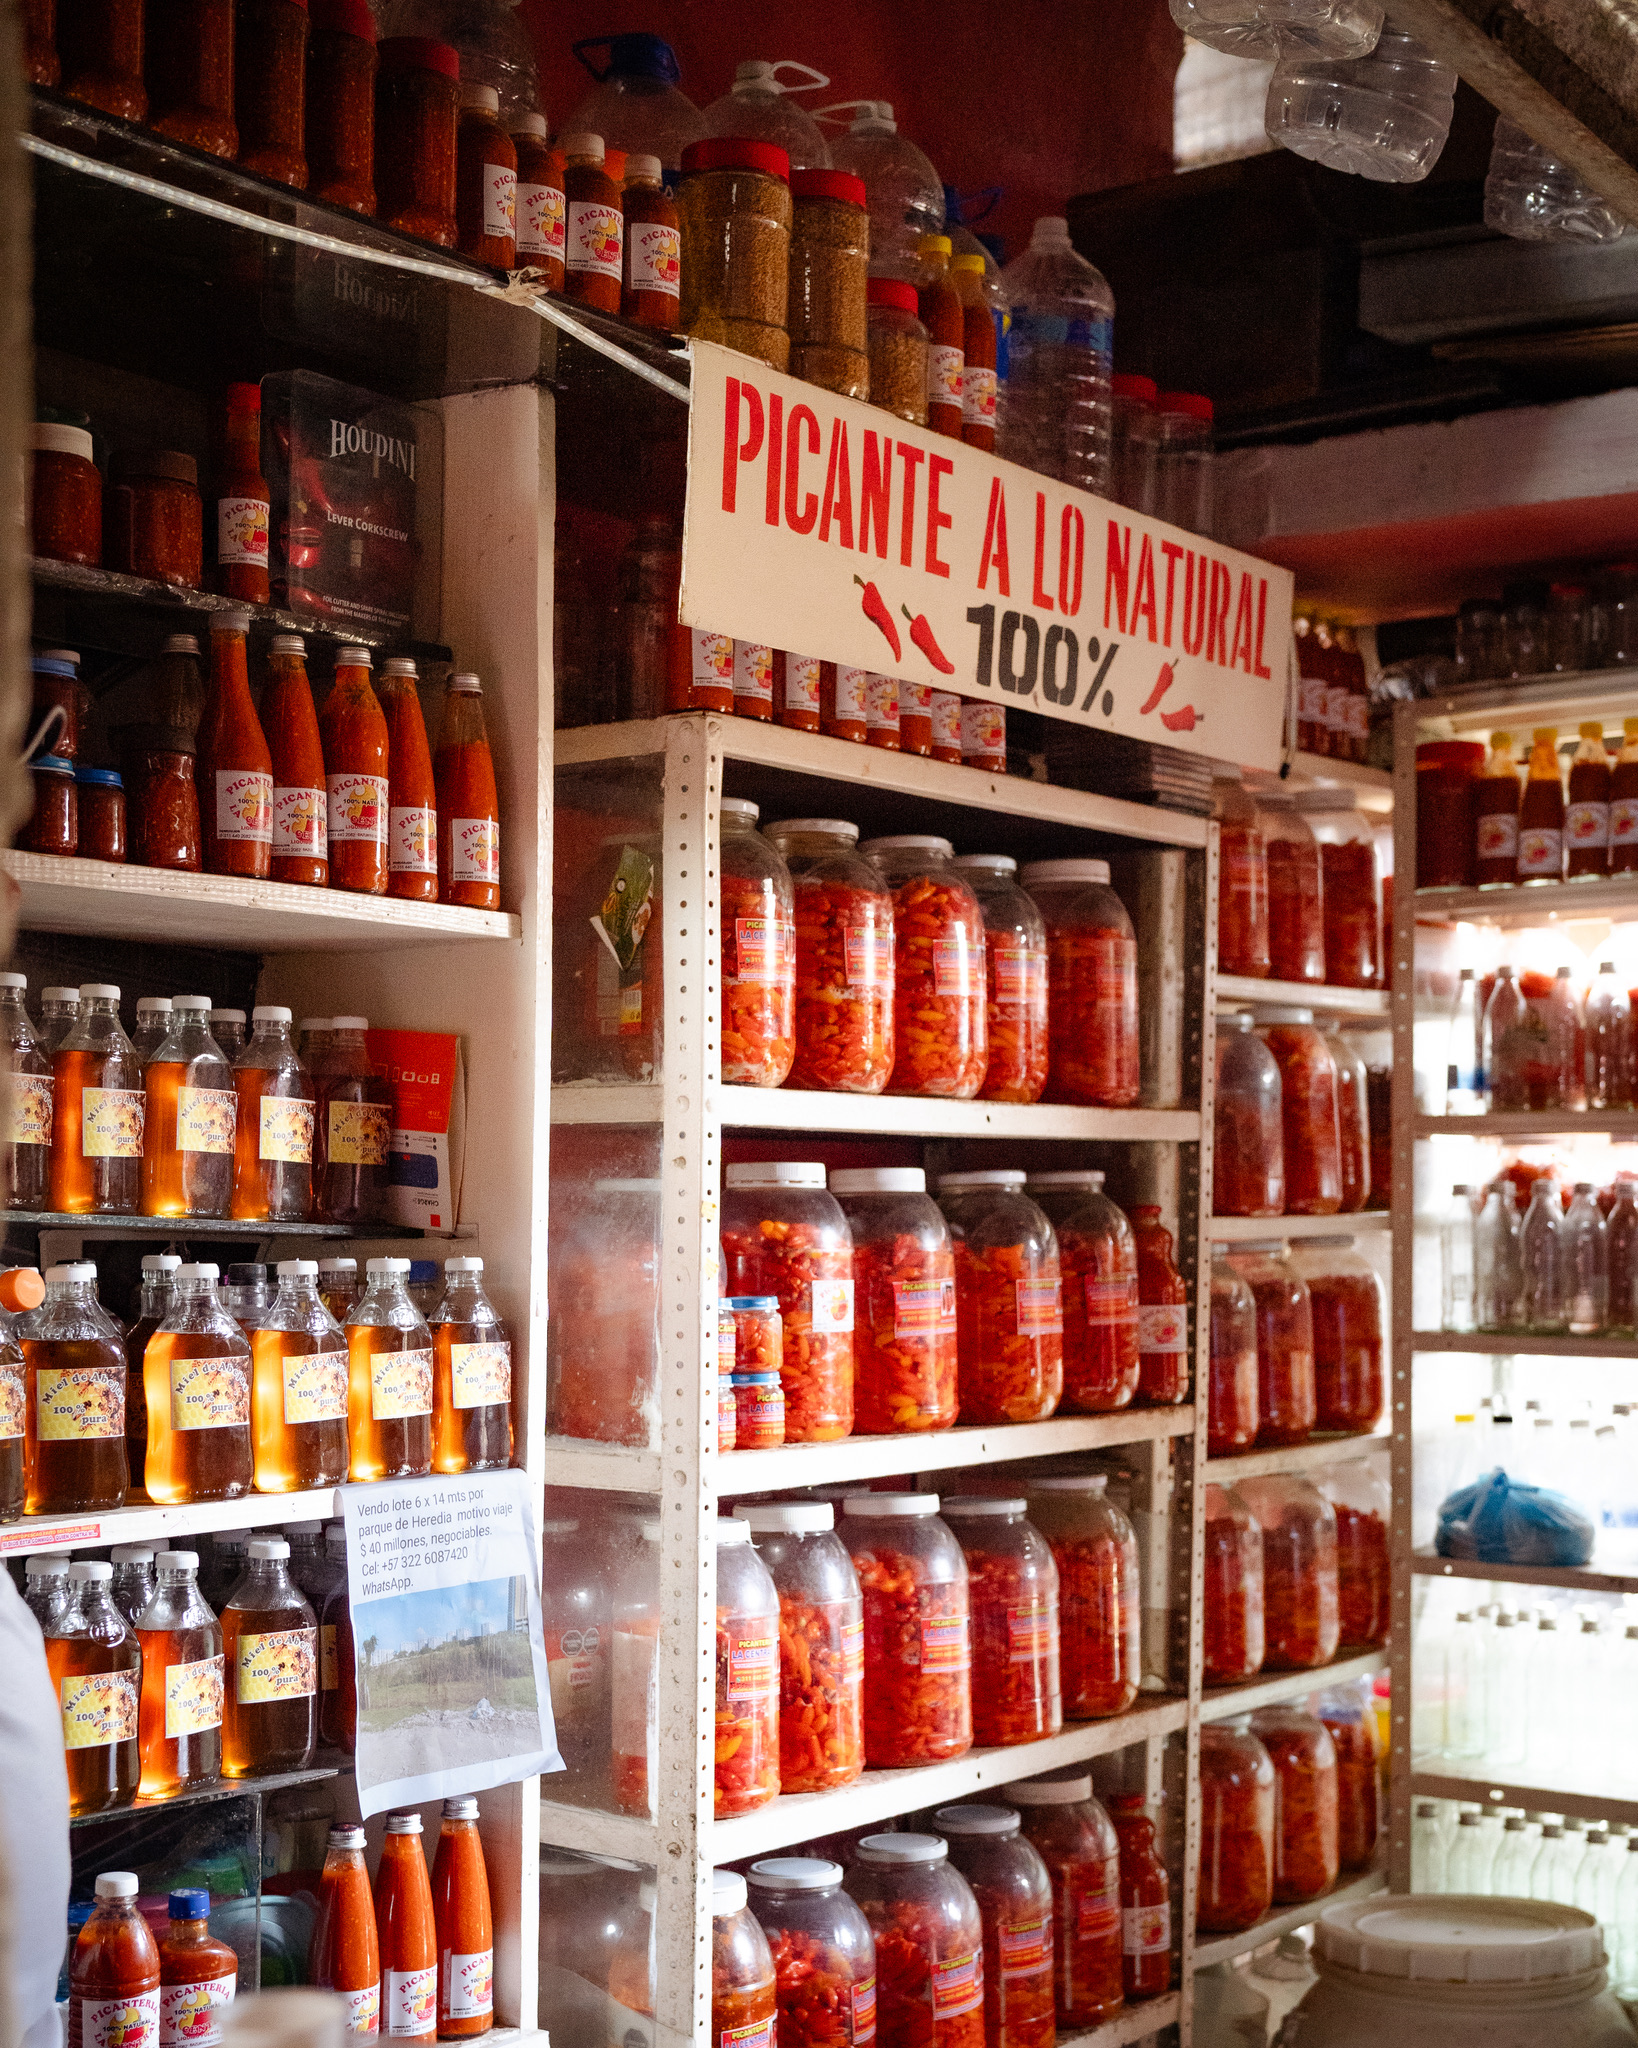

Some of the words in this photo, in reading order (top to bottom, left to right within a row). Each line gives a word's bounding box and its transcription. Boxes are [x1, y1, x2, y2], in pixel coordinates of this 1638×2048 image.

[329, 418, 417, 482] HOUDINI
[327, 509, 353, 528] LEVER
[355, 517, 408, 543] CORKSCREW
[722, 376, 954, 579] PICANTE
[977, 476, 1011, 598] A
[1032, 491, 1085, 617] LO
[1104, 519, 1271, 681] NATURAL
[966, 603, 1120, 717] 100%
[229, 805, 242, 819] LA
[335, 804, 346, 819] LA
[279, 819, 290, 834] LA
[402, 838, 412, 851] LA
[464, 848, 474, 862] LA
[87, 1099, 108, 1123] Miel
[110, 1096, 122, 1104] de
[181, 1096, 201, 1119] Miel
[203, 1094, 214, 1103] de
[264, 1107, 283, 1129] Miel
[286, 1105, 295, 1113] de
[333, 1112, 354, 1134] Miel
[22, 1122, 41, 1131] pura
[117, 1136, 134, 1144] pura
[456, 1352, 475, 1375] Miel
[477, 1347, 488, 1356] de
[175, 1367, 199, 1394] Miel
[202, 1363, 216, 1372] de
[218, 1362, 248, 1391] Abejas
[287, 1362, 310, 1389] Miel
[311, 1359, 323, 1368] de
[373, 1360, 394, 1385] Miel
[396, 1356, 408, 1365] de
[42, 1377, 68, 1404] Miel
[71, 1374, 87, 1384] de
[90, 1373, 125, 1404] Abejas
[485, 1384, 501, 1393] pura
[319, 1397, 338, 1406] pura
[404, 1393, 421, 1402] pura
[211, 1404, 233, 1413] pura
[750, 1404, 762, 1412] LA
[81, 1415, 107, 1425] pura
[357, 1501, 390, 1516] Vendo
[392, 1499, 412, 1512] lote
[415, 1496, 422, 1508] 6
[424, 1497, 430, 1507] x
[433, 1492, 445, 1505] 14
[447, 1491, 466, 1503] mts
[468, 1488, 484, 1503] por
[358, 1522, 392, 1540] parque
[395, 1517, 409, 1531] de
[412, 1512, 452, 1528] Heredia
[457, 1506, 491, 1521] motivo
[492, 1503, 513, 1517] viaje
[360, 1543, 367, 1557] $
[369, 1541, 381, 1554] 40
[384, 1536, 428, 1553] millones,
[431, 1525, 493, 1545] negociables.
[361, 1563, 380, 1577] Cel:
[381, 1557, 398, 1571] +57
[401, 1554, 422, 1569] 322
[424, 1546, 469, 1564] 6087420
[361, 1577, 414, 1596] WhatsApp.
[241, 1643, 265, 1668] Miel
[268, 1638, 282, 1647] de
[732, 1650, 744, 1659] LA
[169, 1673, 190, 1700] Miel
[192, 1667, 202, 1677] de
[276, 1674, 298, 1686] pura
[65, 1684, 90, 1712] Miel
[93, 1678, 108, 1689] de
[197, 1705, 214, 1716] pura
[101, 1720, 123, 1730] pura
[161, 1982, 231, 2008] PICANTERIA
[463, 1985, 472, 1997] LA
[90, 1998, 158, 2024] PICANTERIA
[174, 2008, 192, 2016] 100%
[401, 2001, 412, 2015] LA
[123, 2019, 151, 2031] NATURAL
[165, 2015, 177, 2031] LA
[94, 2032, 106, 2048] LA
